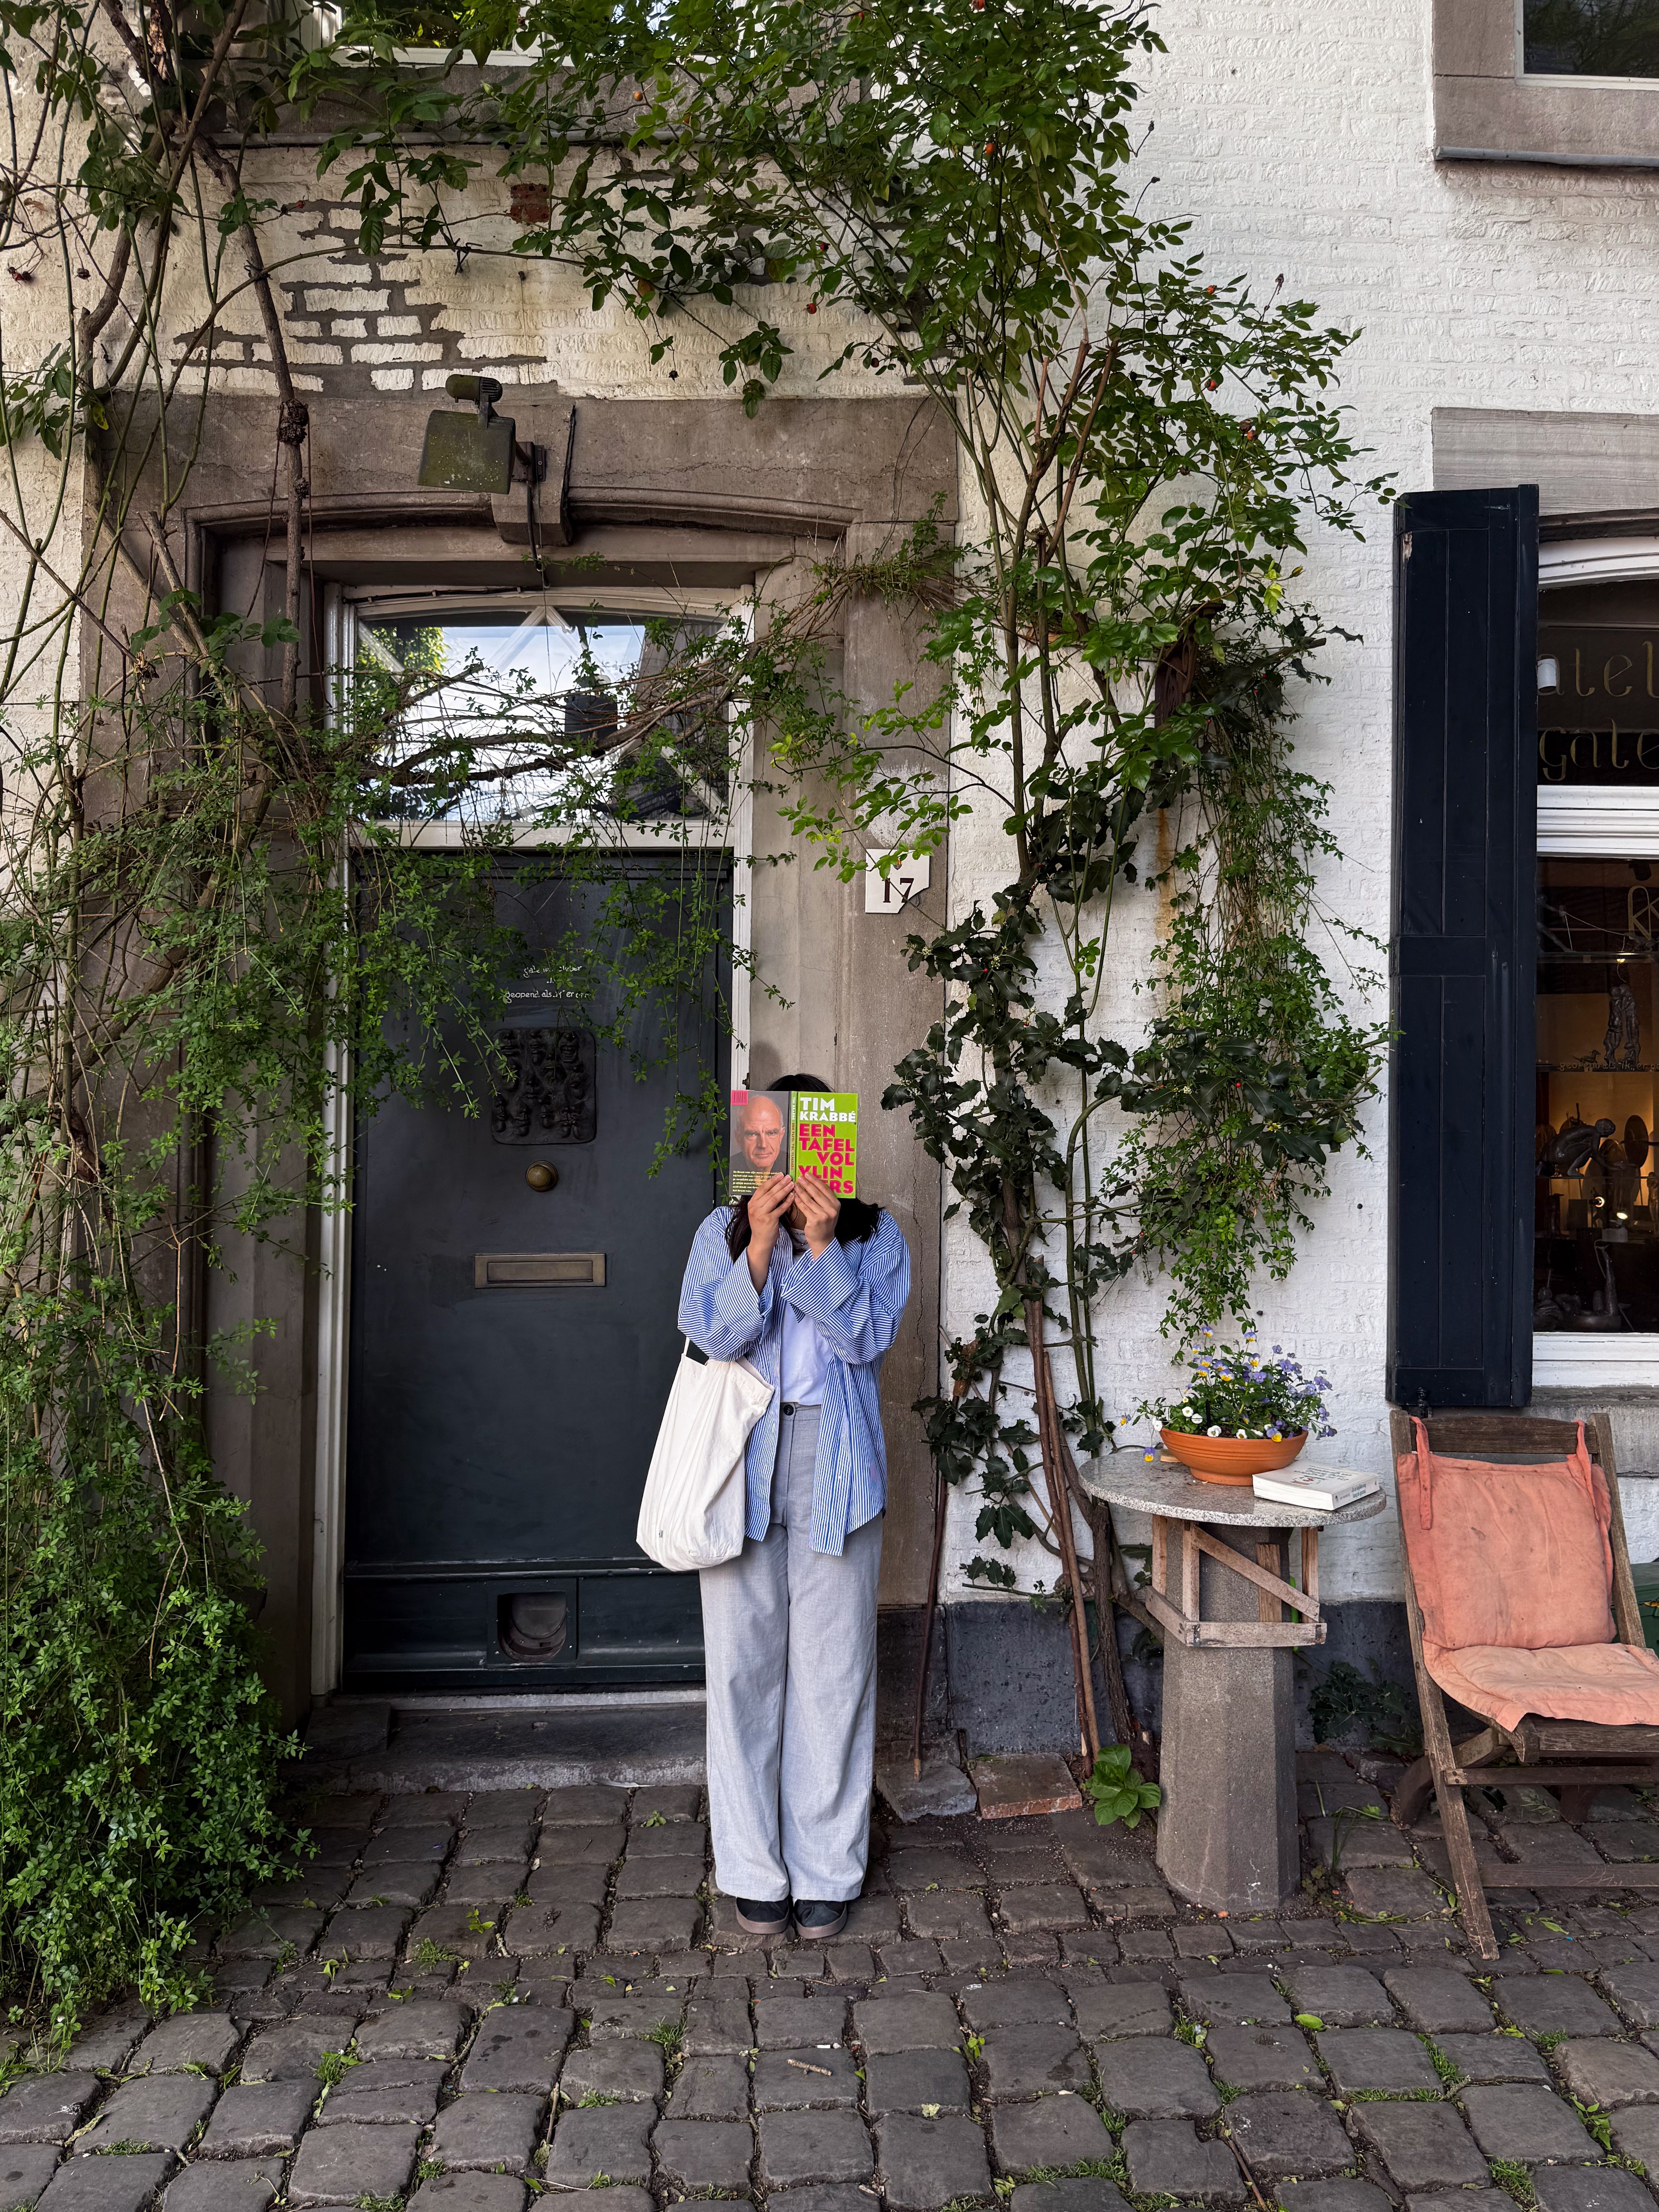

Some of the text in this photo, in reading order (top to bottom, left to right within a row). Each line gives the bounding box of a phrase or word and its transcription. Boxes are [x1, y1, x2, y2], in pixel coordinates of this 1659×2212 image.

[882, 877, 914, 903] 17
[800, 1097, 835, 1111] TIM
[799, 1111, 856, 1122] KRABBÉ
[799, 1123, 835, 1138] EEN
[798, 1137, 855, 1152] TAFEL
[817, 1152, 854, 1166] VOL
[798, 1165, 843, 1179] VLIN
